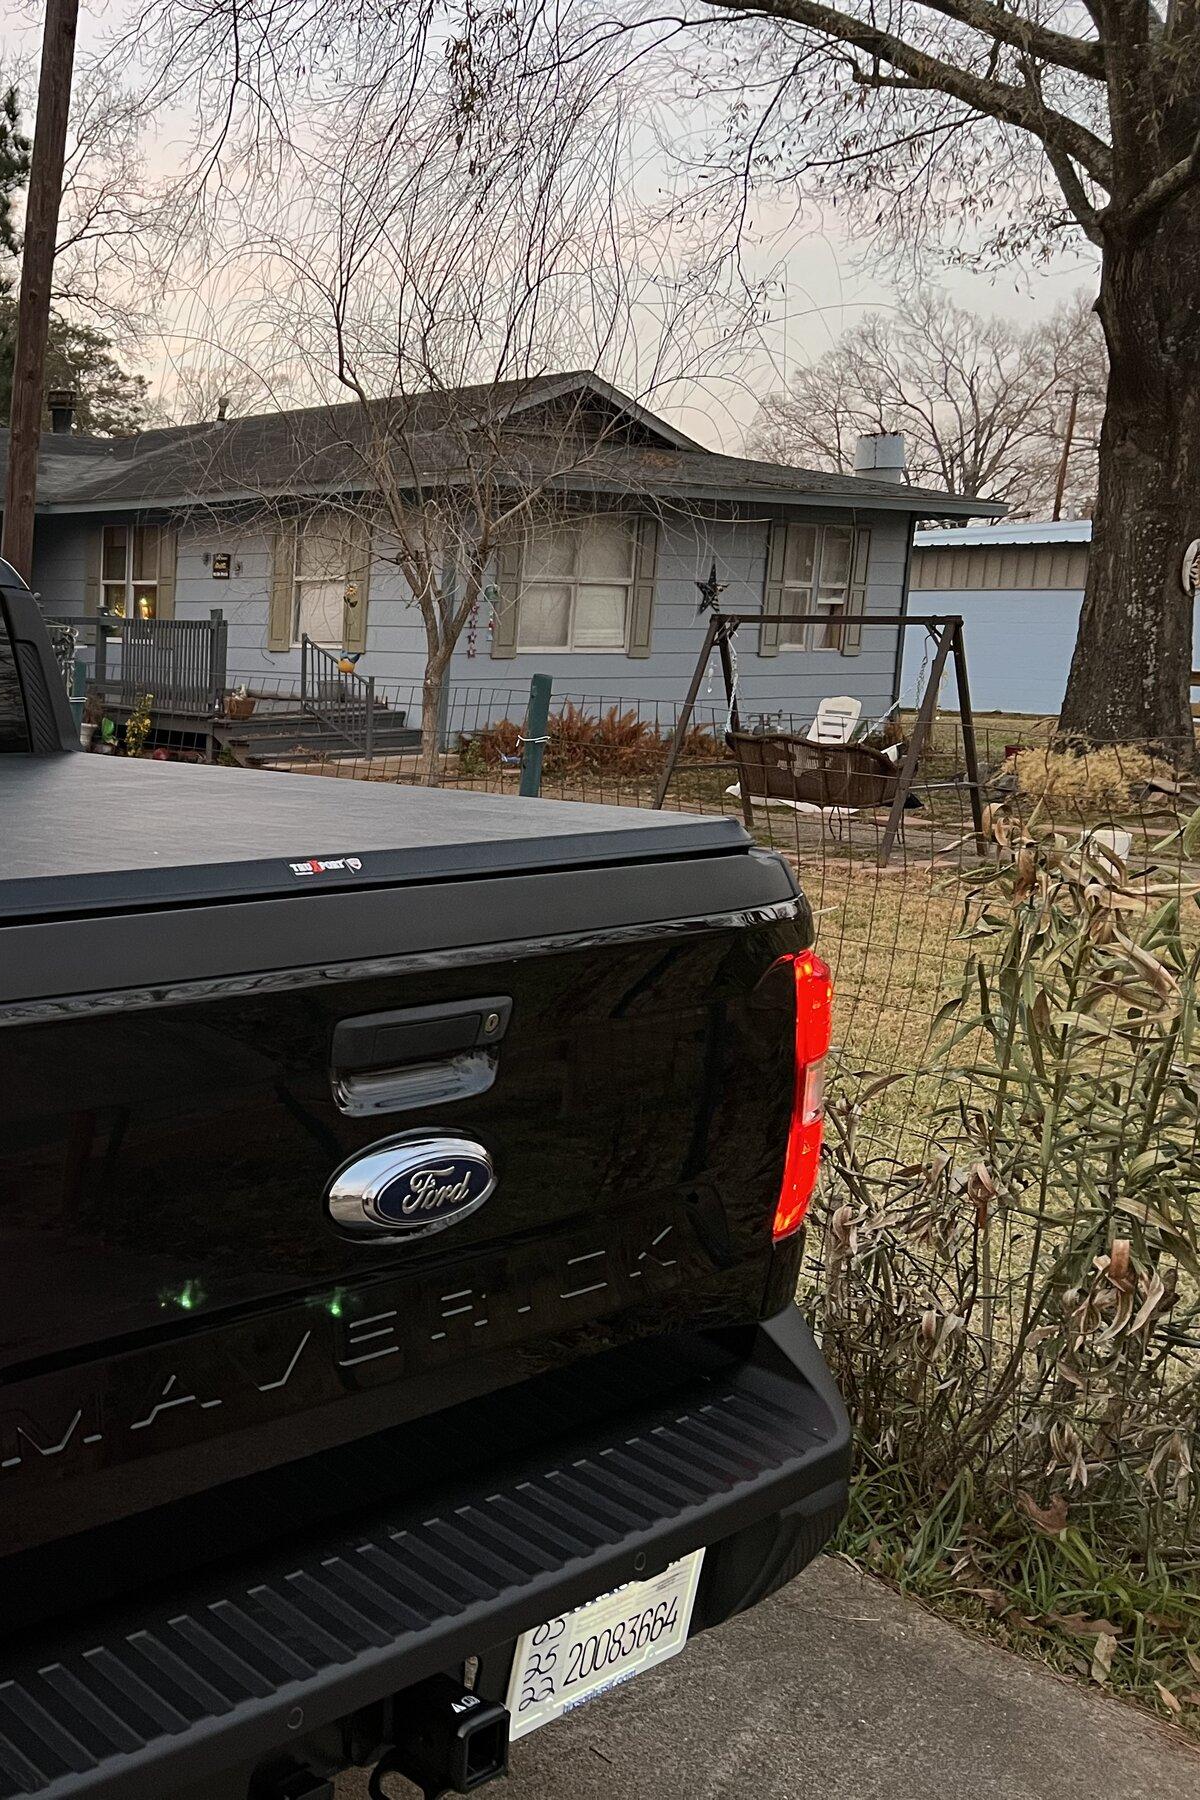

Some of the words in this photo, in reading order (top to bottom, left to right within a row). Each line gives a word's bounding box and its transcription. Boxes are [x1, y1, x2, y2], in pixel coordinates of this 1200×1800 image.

[402, 1166, 472, 1214] Ford
[0, 1225, 678, 1468] MAVERICK
[563, 1595, 678, 1686] 20083664
